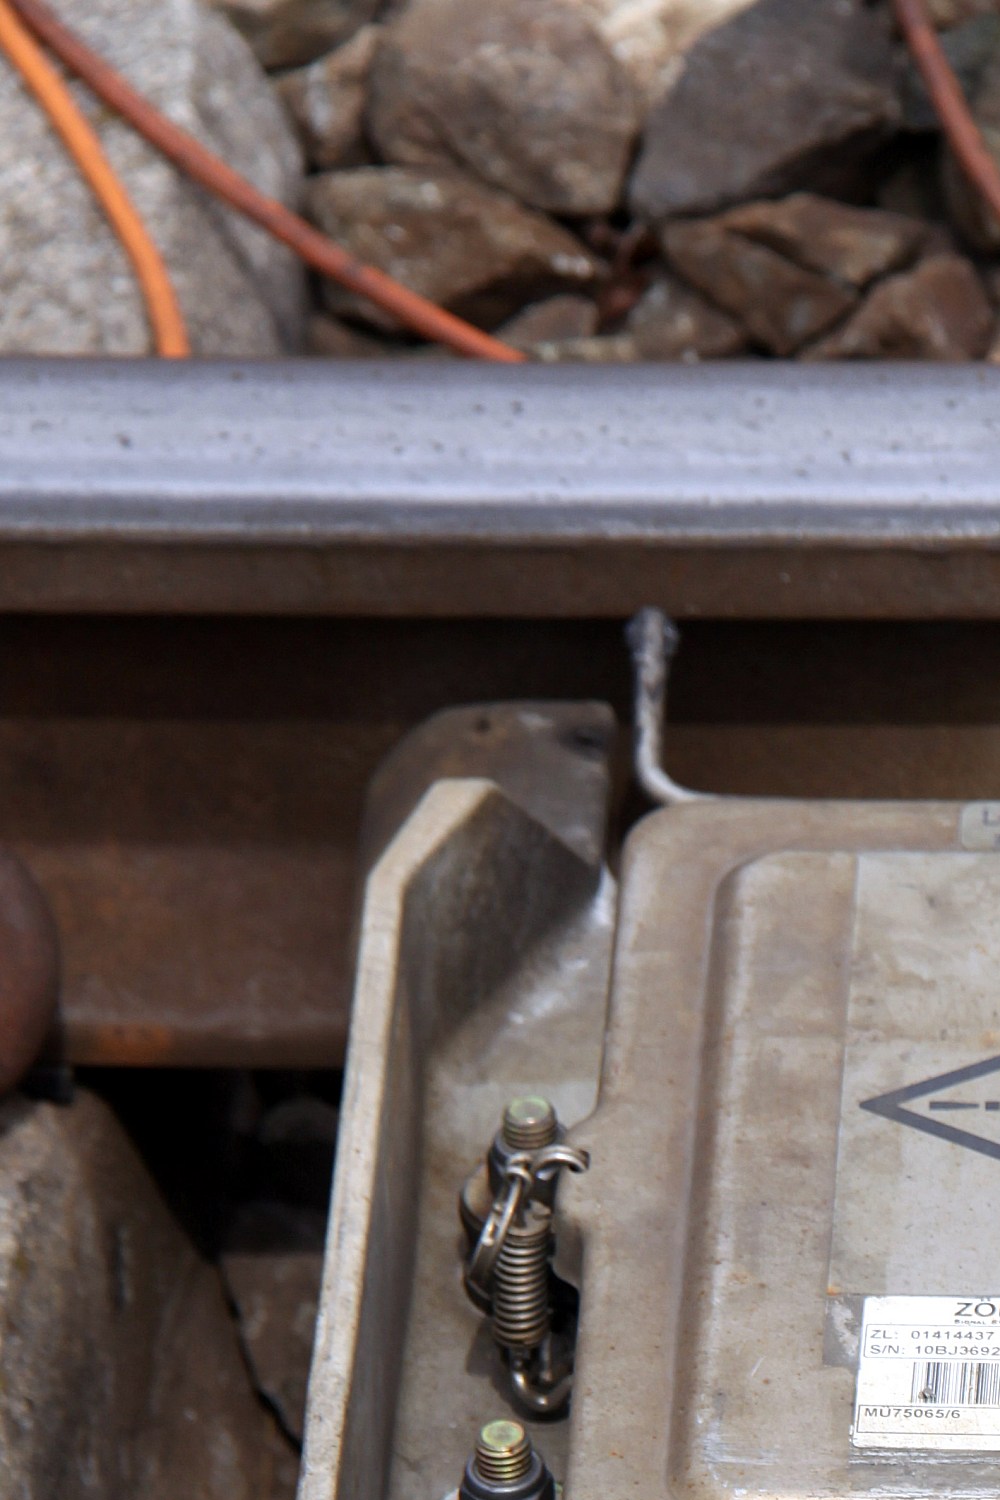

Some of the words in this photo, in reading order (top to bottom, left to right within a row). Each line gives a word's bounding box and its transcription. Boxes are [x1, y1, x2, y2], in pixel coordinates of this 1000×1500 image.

[870, 1330, 899, 1339] ZL:
[911, 1330, 995, 1341] 01414437
[870, 1345, 905, 1354] S/N:
[864, 1405, 961, 1419] MÜ75065/6
